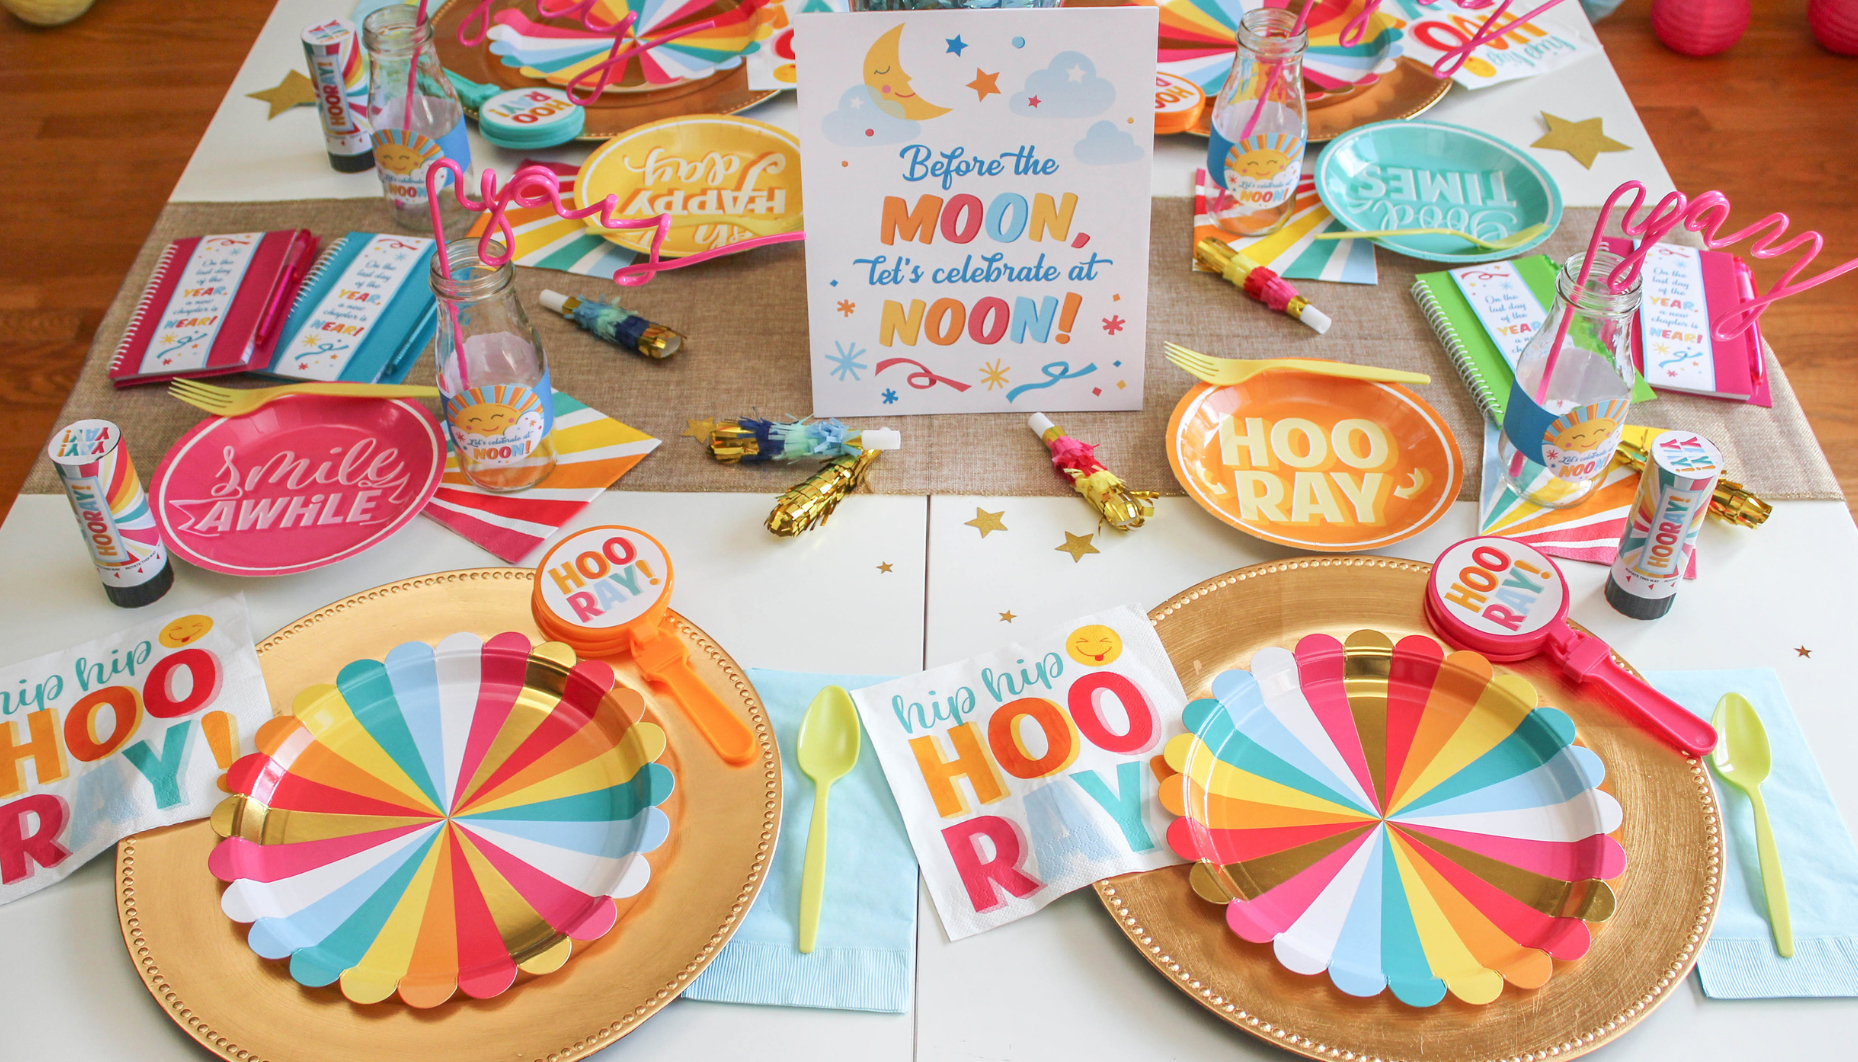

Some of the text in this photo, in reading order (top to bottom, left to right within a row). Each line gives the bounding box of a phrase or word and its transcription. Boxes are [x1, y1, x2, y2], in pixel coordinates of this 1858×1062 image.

[317, 61, 346, 126] HOORAY!
[511, 99, 572, 123] HOO
[624, 147, 741, 187] day
[899, 144, 1059, 190] Before the
[1352, 165, 1517, 208] TIMES
[881, 192, 1091, 249] MOON,
[1240, 188, 1289, 203] NOON!
[932, 252, 1060, 284] celebrate
[1068, 252, 1114, 281] at
[163, 315, 219, 330] NEAR!
[309, 319, 365, 336] NEAR!
[879, 291, 1082, 347] NOON!
[1650, 327, 1703, 344] NEAR!
[473, 440, 532, 460] NOON!
[1220, 417, 1390, 468] HOO
[1559, 453, 1611, 478] NOON!
[71, 484, 118, 556] HOORAY!
[1235, 470, 1386, 523] RAY
[1646, 495, 1690, 569] HOORAY!
[547, 537, 637, 595] HOO
[566, 559, 660, 623] RAY!
[1444, 546, 1511, 613] HOO
[1482, 560, 1552, 632] RAY!
[75, 641, 152, 702] hip
[892, 652, 1064, 734] hip hip
[0, 649, 222, 800] HOO
[908, 671, 1161, 820] HOO
